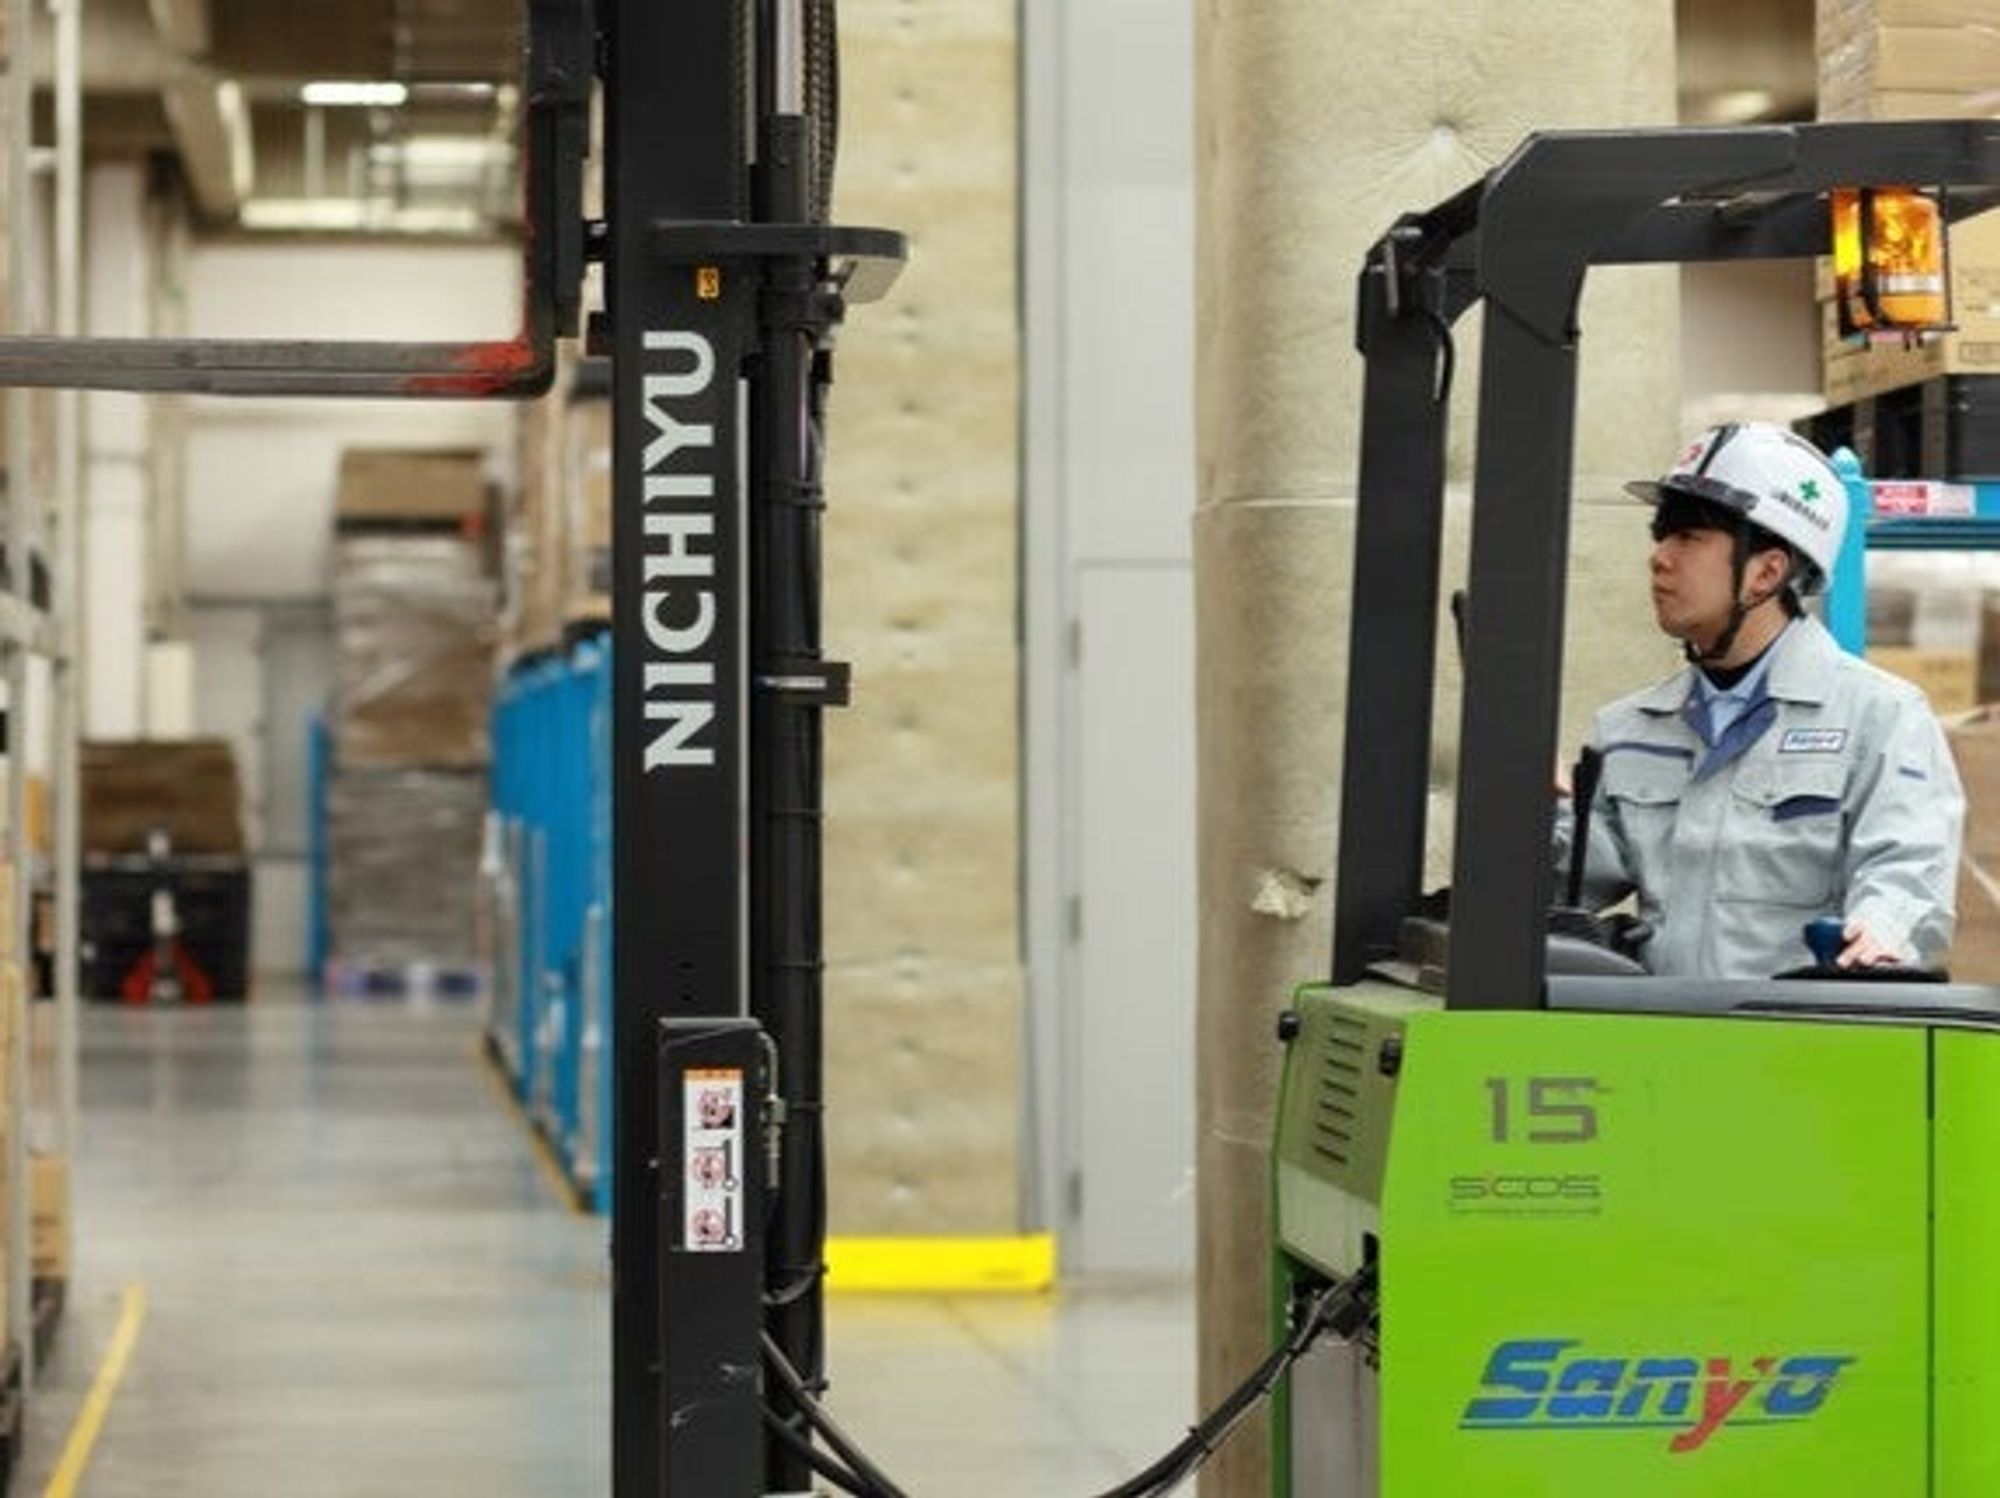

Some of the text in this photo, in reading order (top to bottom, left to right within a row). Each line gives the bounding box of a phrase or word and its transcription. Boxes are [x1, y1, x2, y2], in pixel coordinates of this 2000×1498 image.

[642, 331, 715, 771] NICHIYU
[1485, 1076, 1600, 1144] 15
[1459, 1339, 1857, 1453] Sanyo
